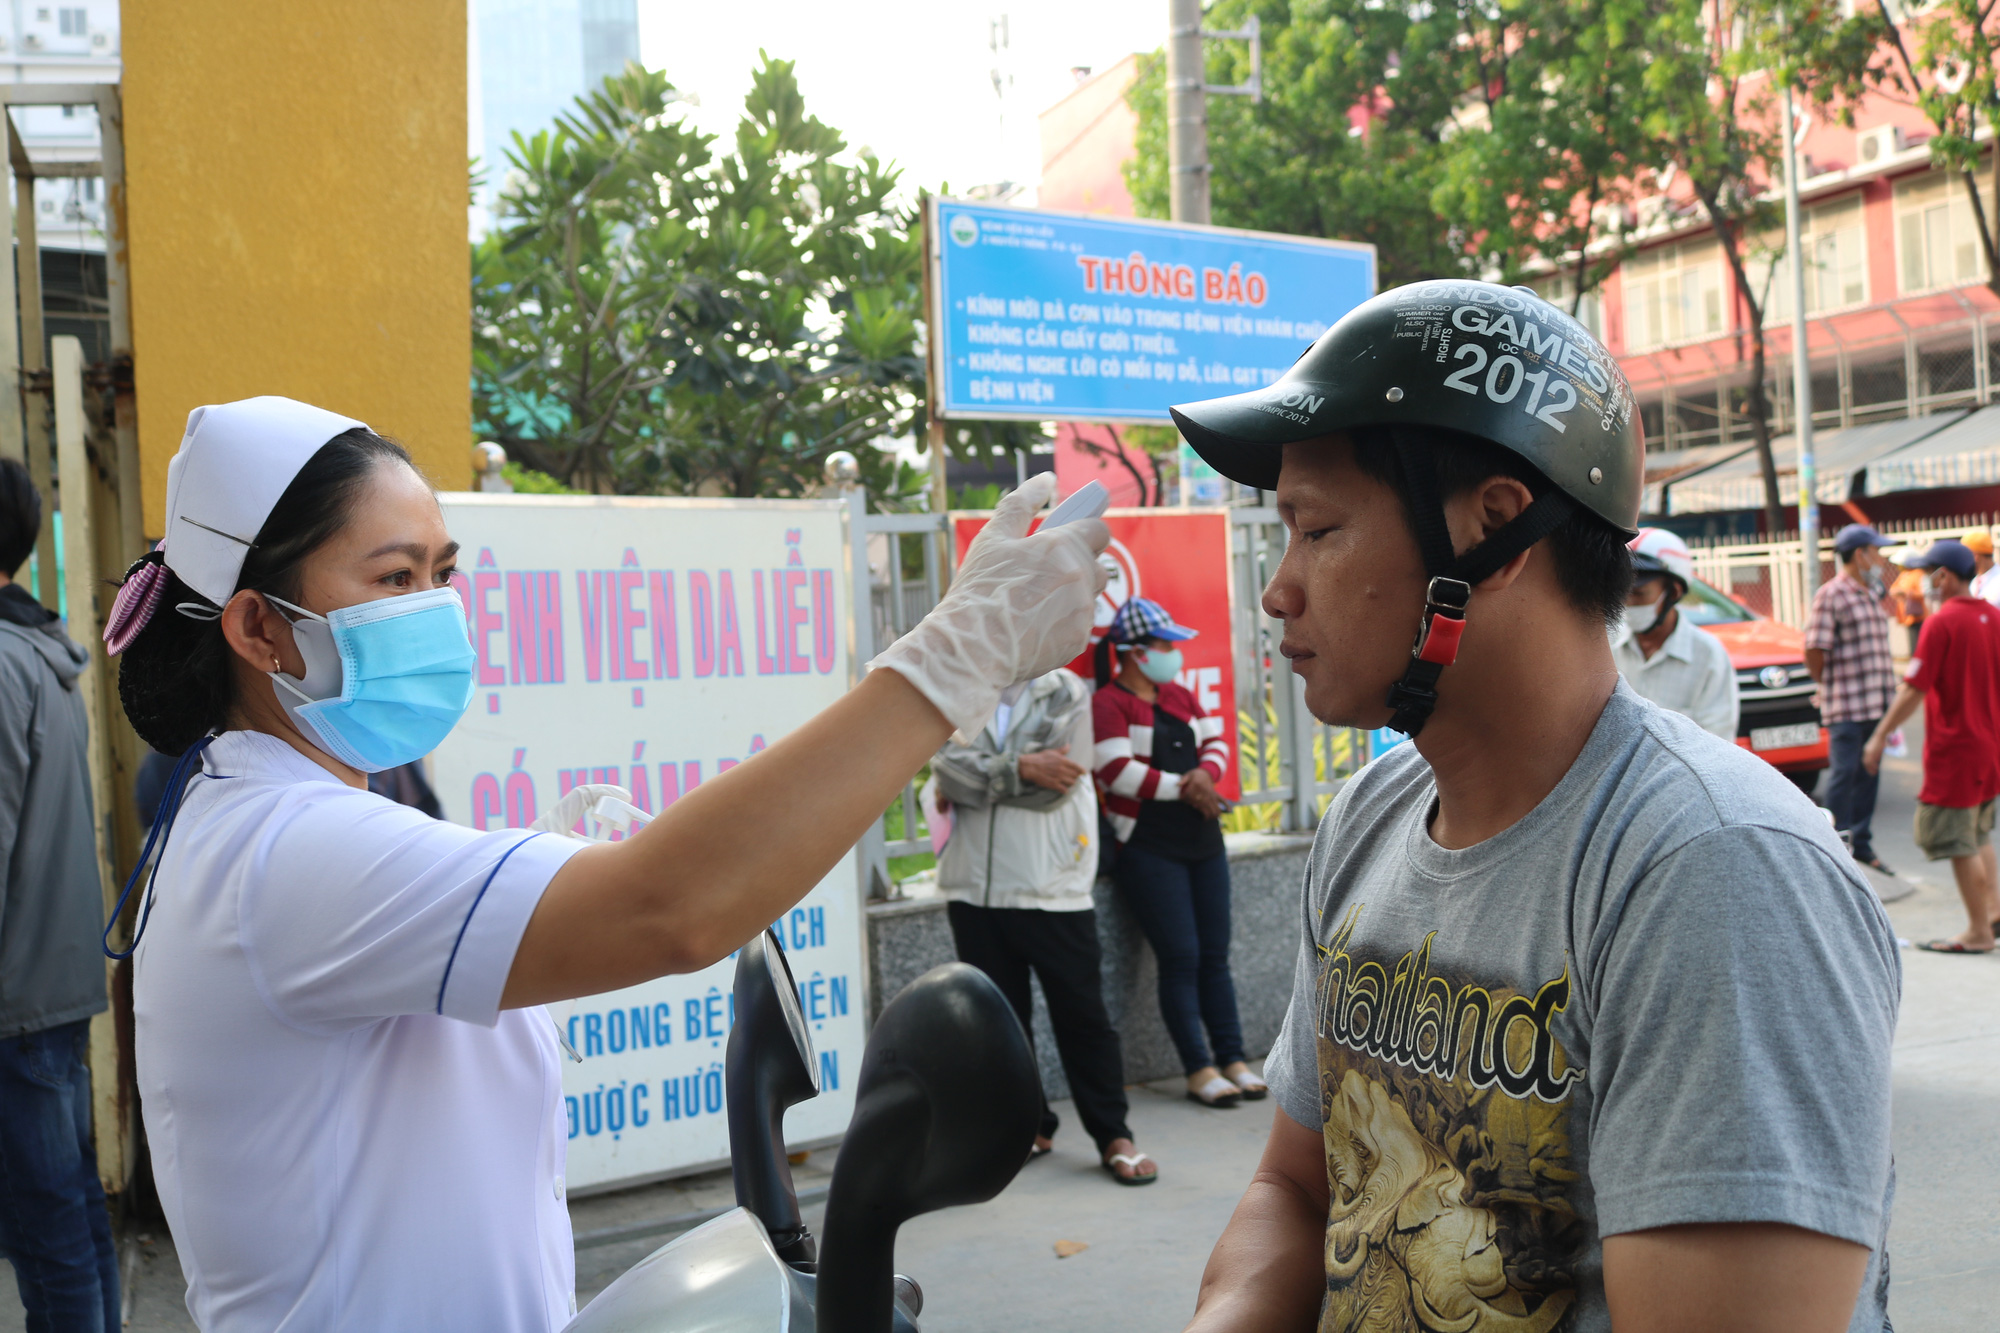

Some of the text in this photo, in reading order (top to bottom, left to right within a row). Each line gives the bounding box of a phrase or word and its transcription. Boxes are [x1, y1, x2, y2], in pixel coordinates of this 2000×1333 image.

[1077, 251, 1267, 307] THÔNG BÁO
[1396, 310, 1432, 318] SUMMER
[1421, 304, 1452, 312] LOGO
[968, 321, 1023, 347] KHÔNG
[1396, 331, 1423, 339] PUBLIC
[1430, 320, 1443, 340] NEW
[1435, 328, 1454, 364] RIGHTS
[969, 348, 1024, 373] KHÔNG
[1452, 305, 1610, 394] GAMES
[1497, 341, 1519, 355] IOC
[970, 376, 1055, 404] BỆNH VIỆN
[1442, 343, 1577, 434] 2012
[1252, 403, 1310, 426] OLYMPIC 2012
[576, 547, 680, 707] VIỆN
[688, 570, 745, 678] DA
[752, 528, 836, 676] LIỄU
[471, 747, 537, 832] CÓ
[1317, 903, 1586, 1104] hailand
[567, 1002, 671, 1060] TRONG
[684, 985, 734, 1048] BỆ
[565, 1080, 649, 1141] ĐƯỢC
